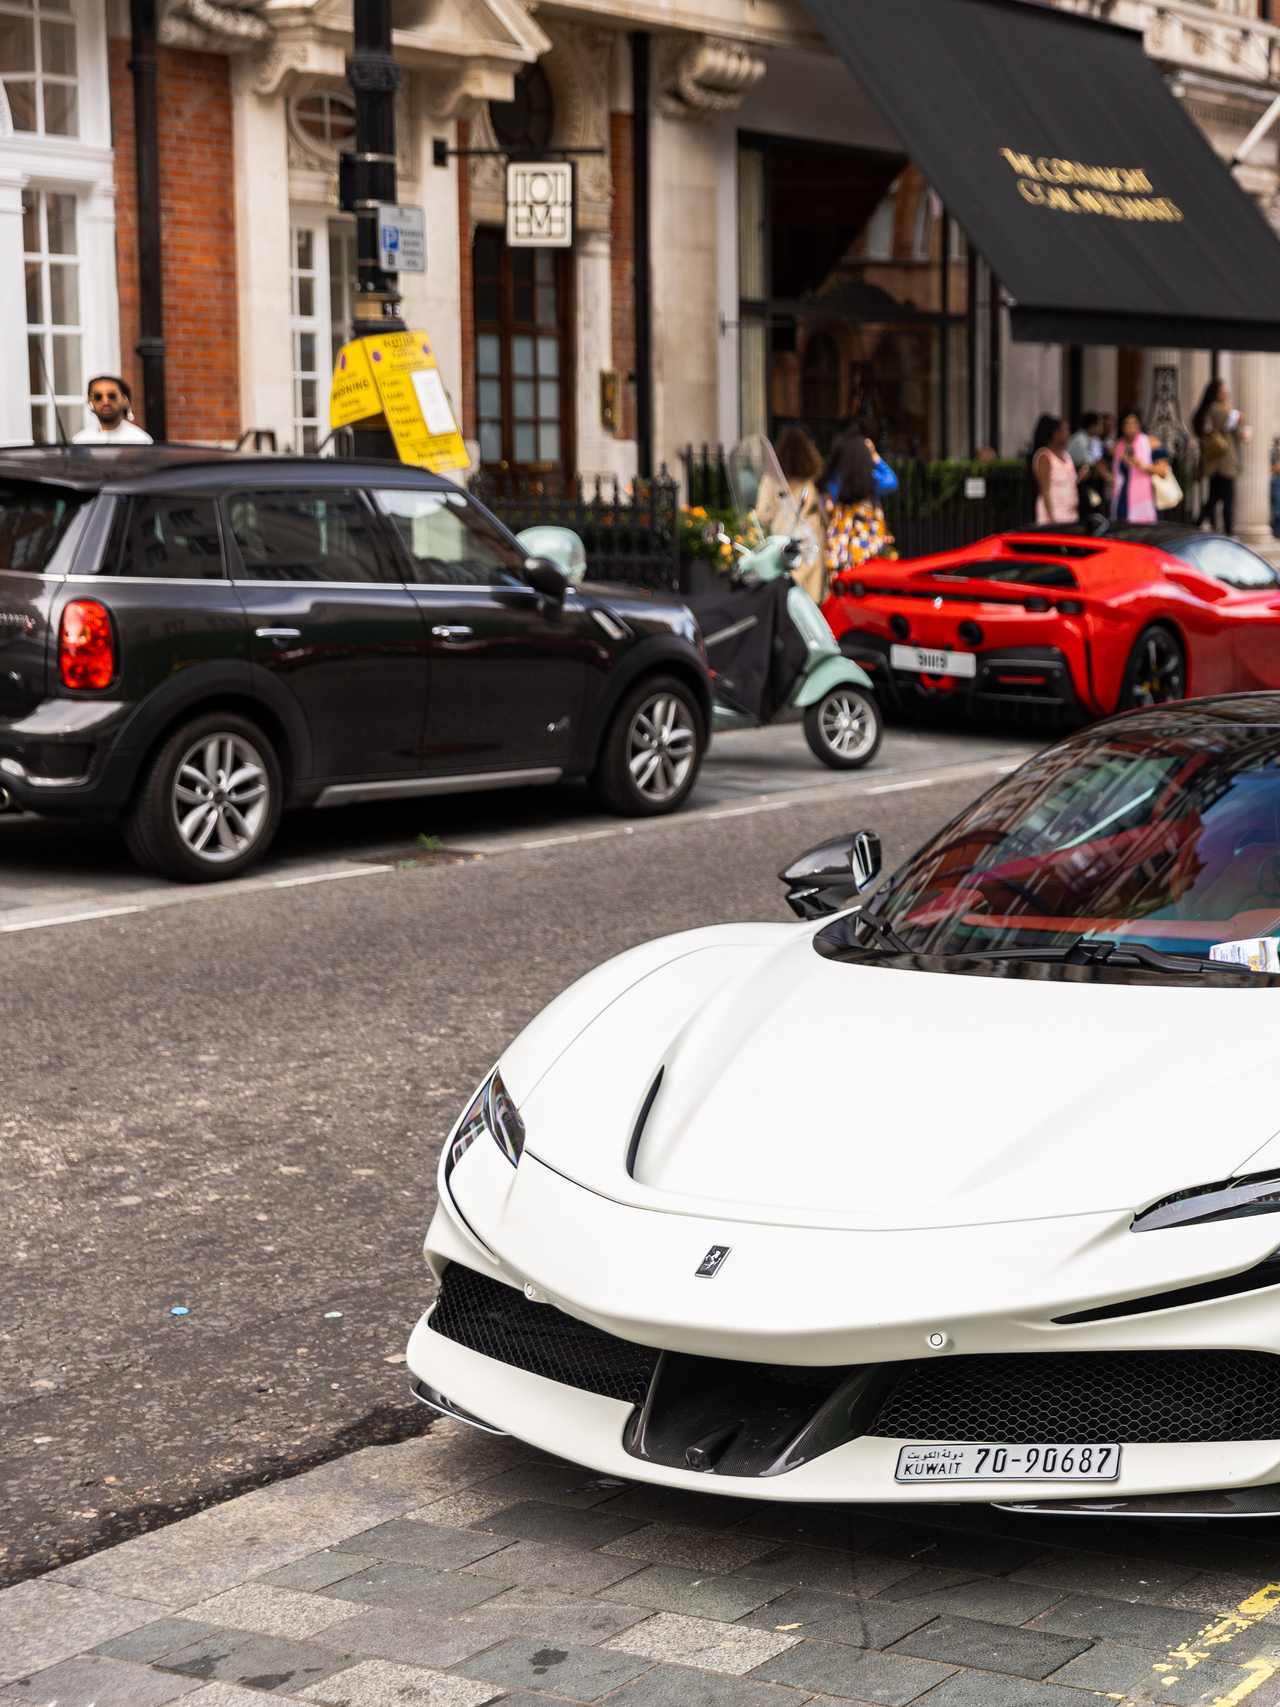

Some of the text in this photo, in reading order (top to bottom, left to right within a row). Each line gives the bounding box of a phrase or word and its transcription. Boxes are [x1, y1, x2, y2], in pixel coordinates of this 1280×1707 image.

[907, 1449, 964, 1461] دولة الكويت
[974, 1447, 1112, 1474] 70-90687
[904, 1462, 962, 1476] KUWAIT
